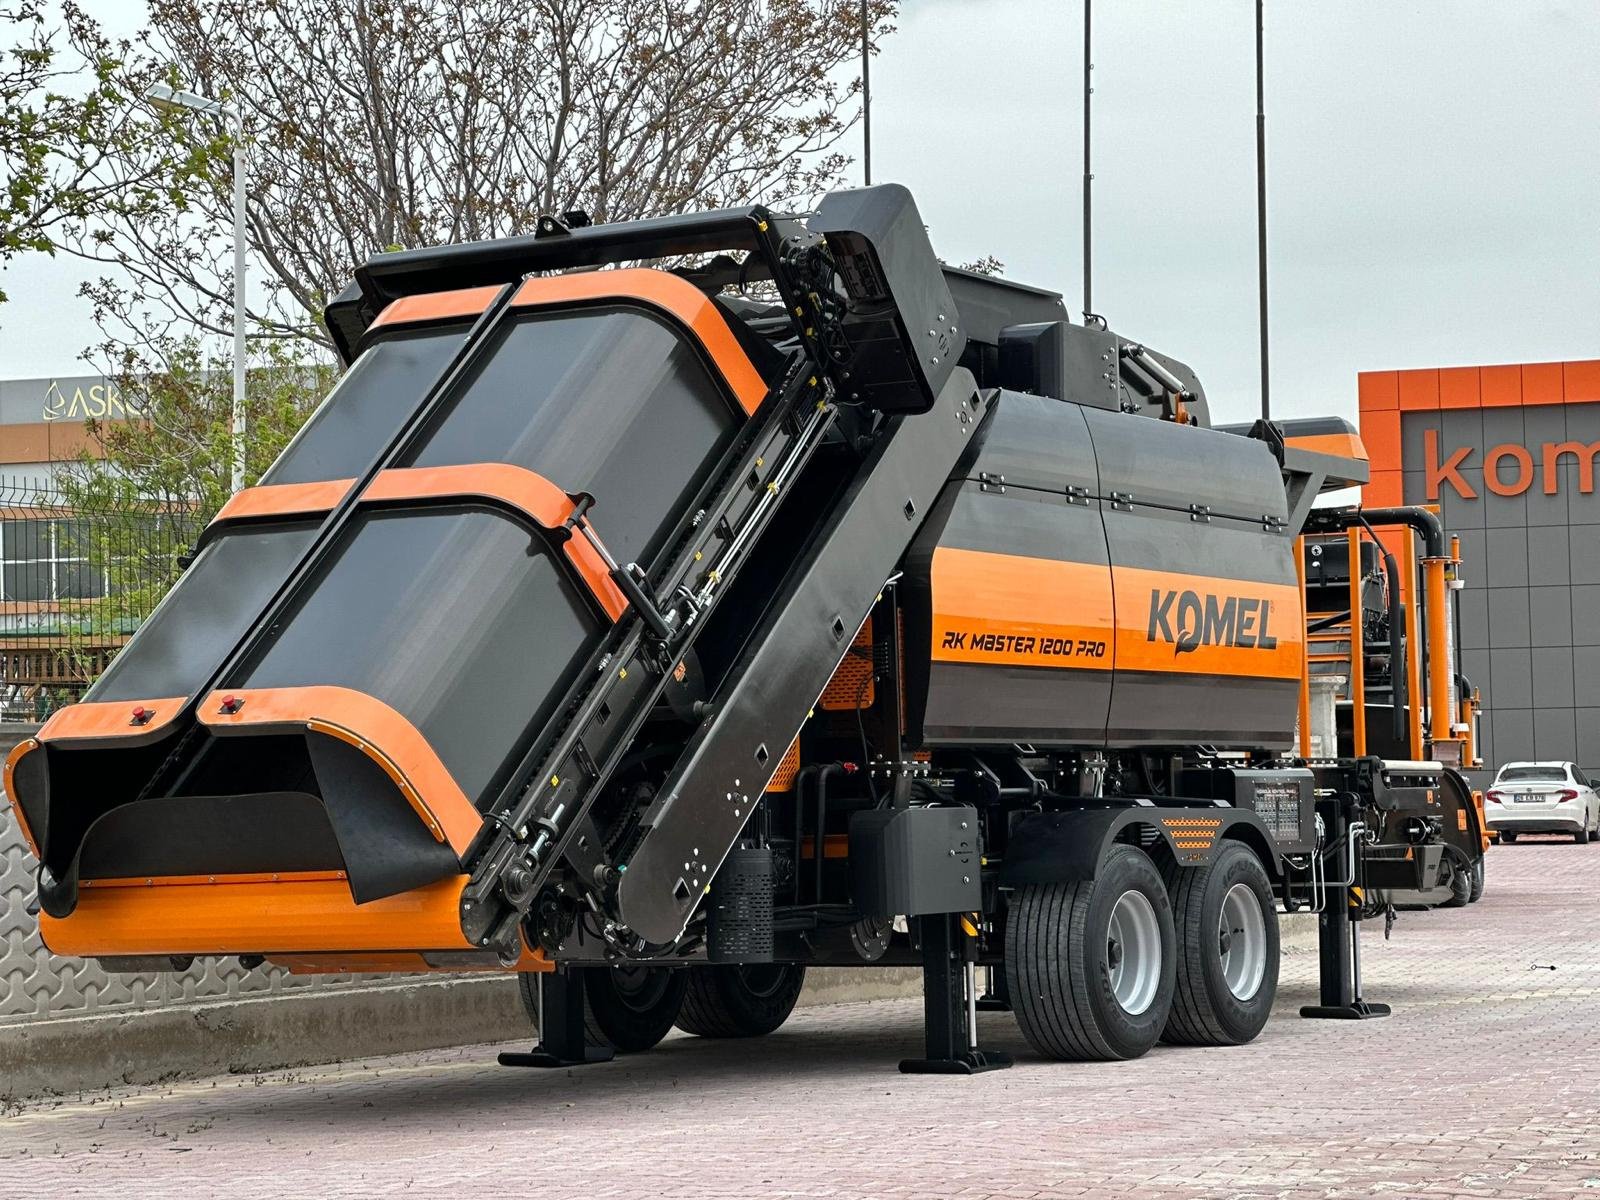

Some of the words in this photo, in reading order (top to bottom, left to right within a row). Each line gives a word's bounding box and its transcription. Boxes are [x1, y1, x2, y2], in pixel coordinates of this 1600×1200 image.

[942, 632, 967, 650] RK
[1039, 637, 1074, 656] 1200
[1076, 640, 1106, 658] PRO
[1147, 589, 1277, 656] KOMEL
